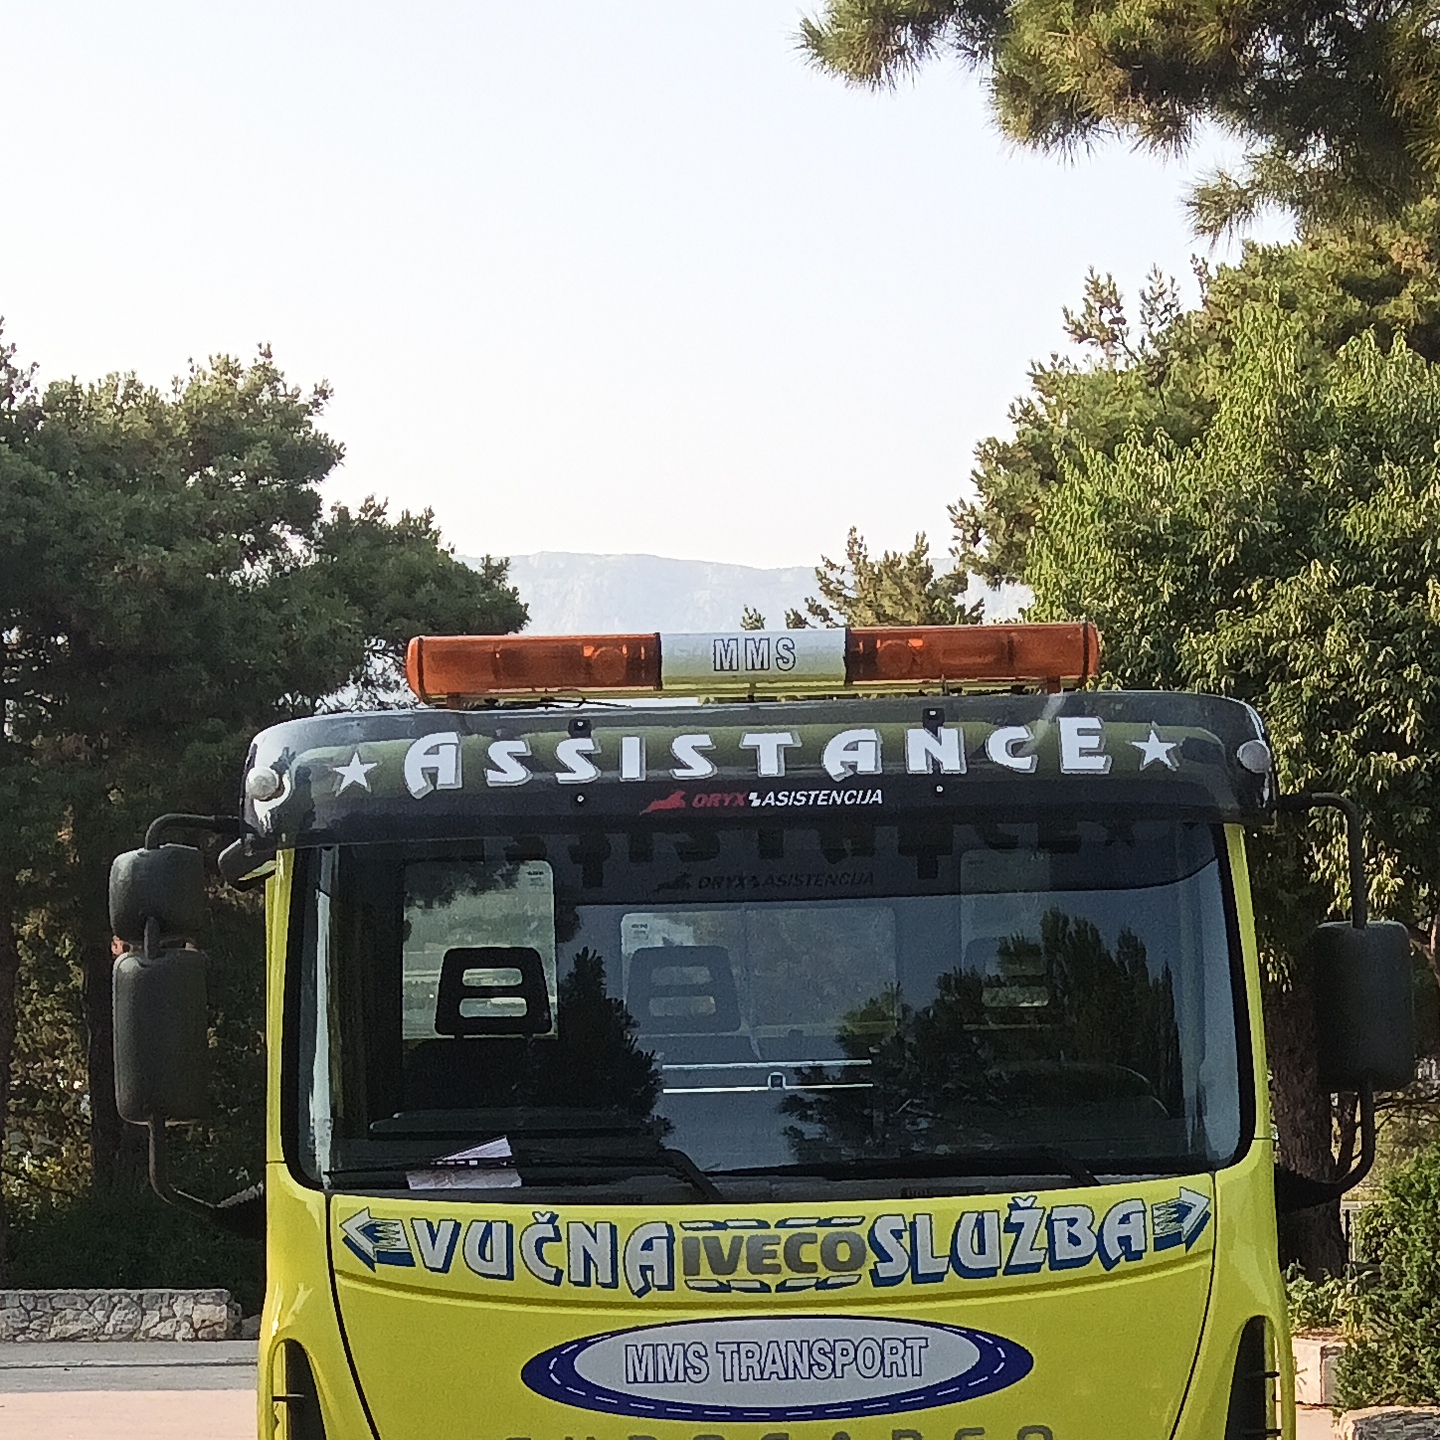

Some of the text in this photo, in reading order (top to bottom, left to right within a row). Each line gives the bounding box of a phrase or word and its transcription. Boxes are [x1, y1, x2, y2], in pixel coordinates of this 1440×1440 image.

[713, 637, 796, 671] MMS
[404, 717, 1112, 798] ASSISTANCE
[692, 789, 883, 807] ORYX ASISTENCIJA
[410, 1196, 1147, 1299] VUČNA IVECO SLUŽBA
[624, 1337, 930, 1384] MMS TRANSPORT
